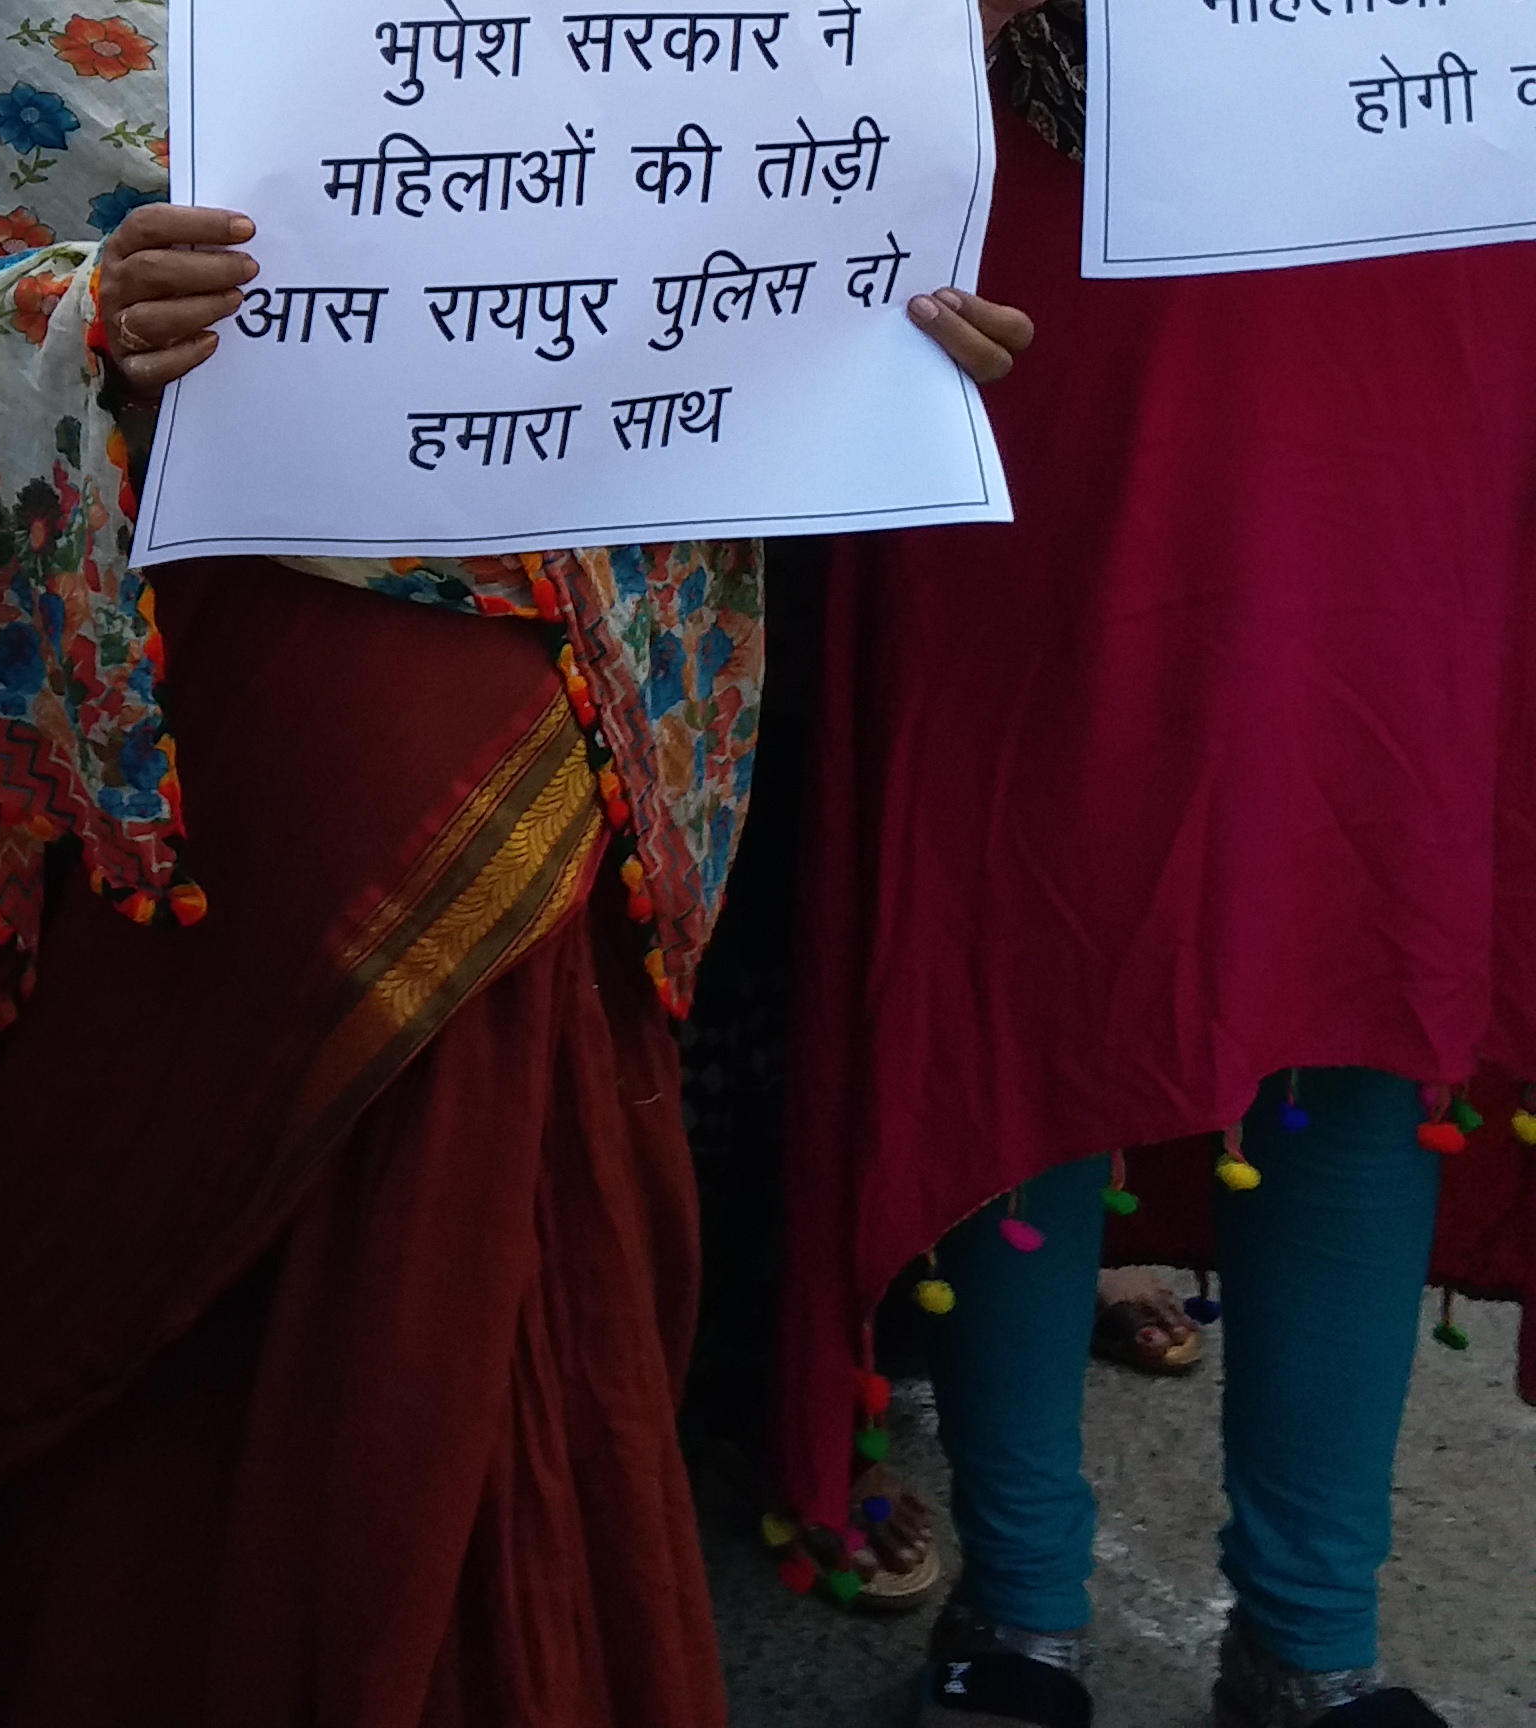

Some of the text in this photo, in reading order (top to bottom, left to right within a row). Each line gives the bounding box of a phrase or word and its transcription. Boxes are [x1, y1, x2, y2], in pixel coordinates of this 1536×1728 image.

[563, 13, 789, 72] सरकार
[1350, 52, 1477, 133] होगी
[321, 116, 889, 217] महिलाओं की तोड़ी
[234, 231, 912, 361] आस रायपुर पुलिस दो
[407, 387, 732, 470] हमारा साथ
